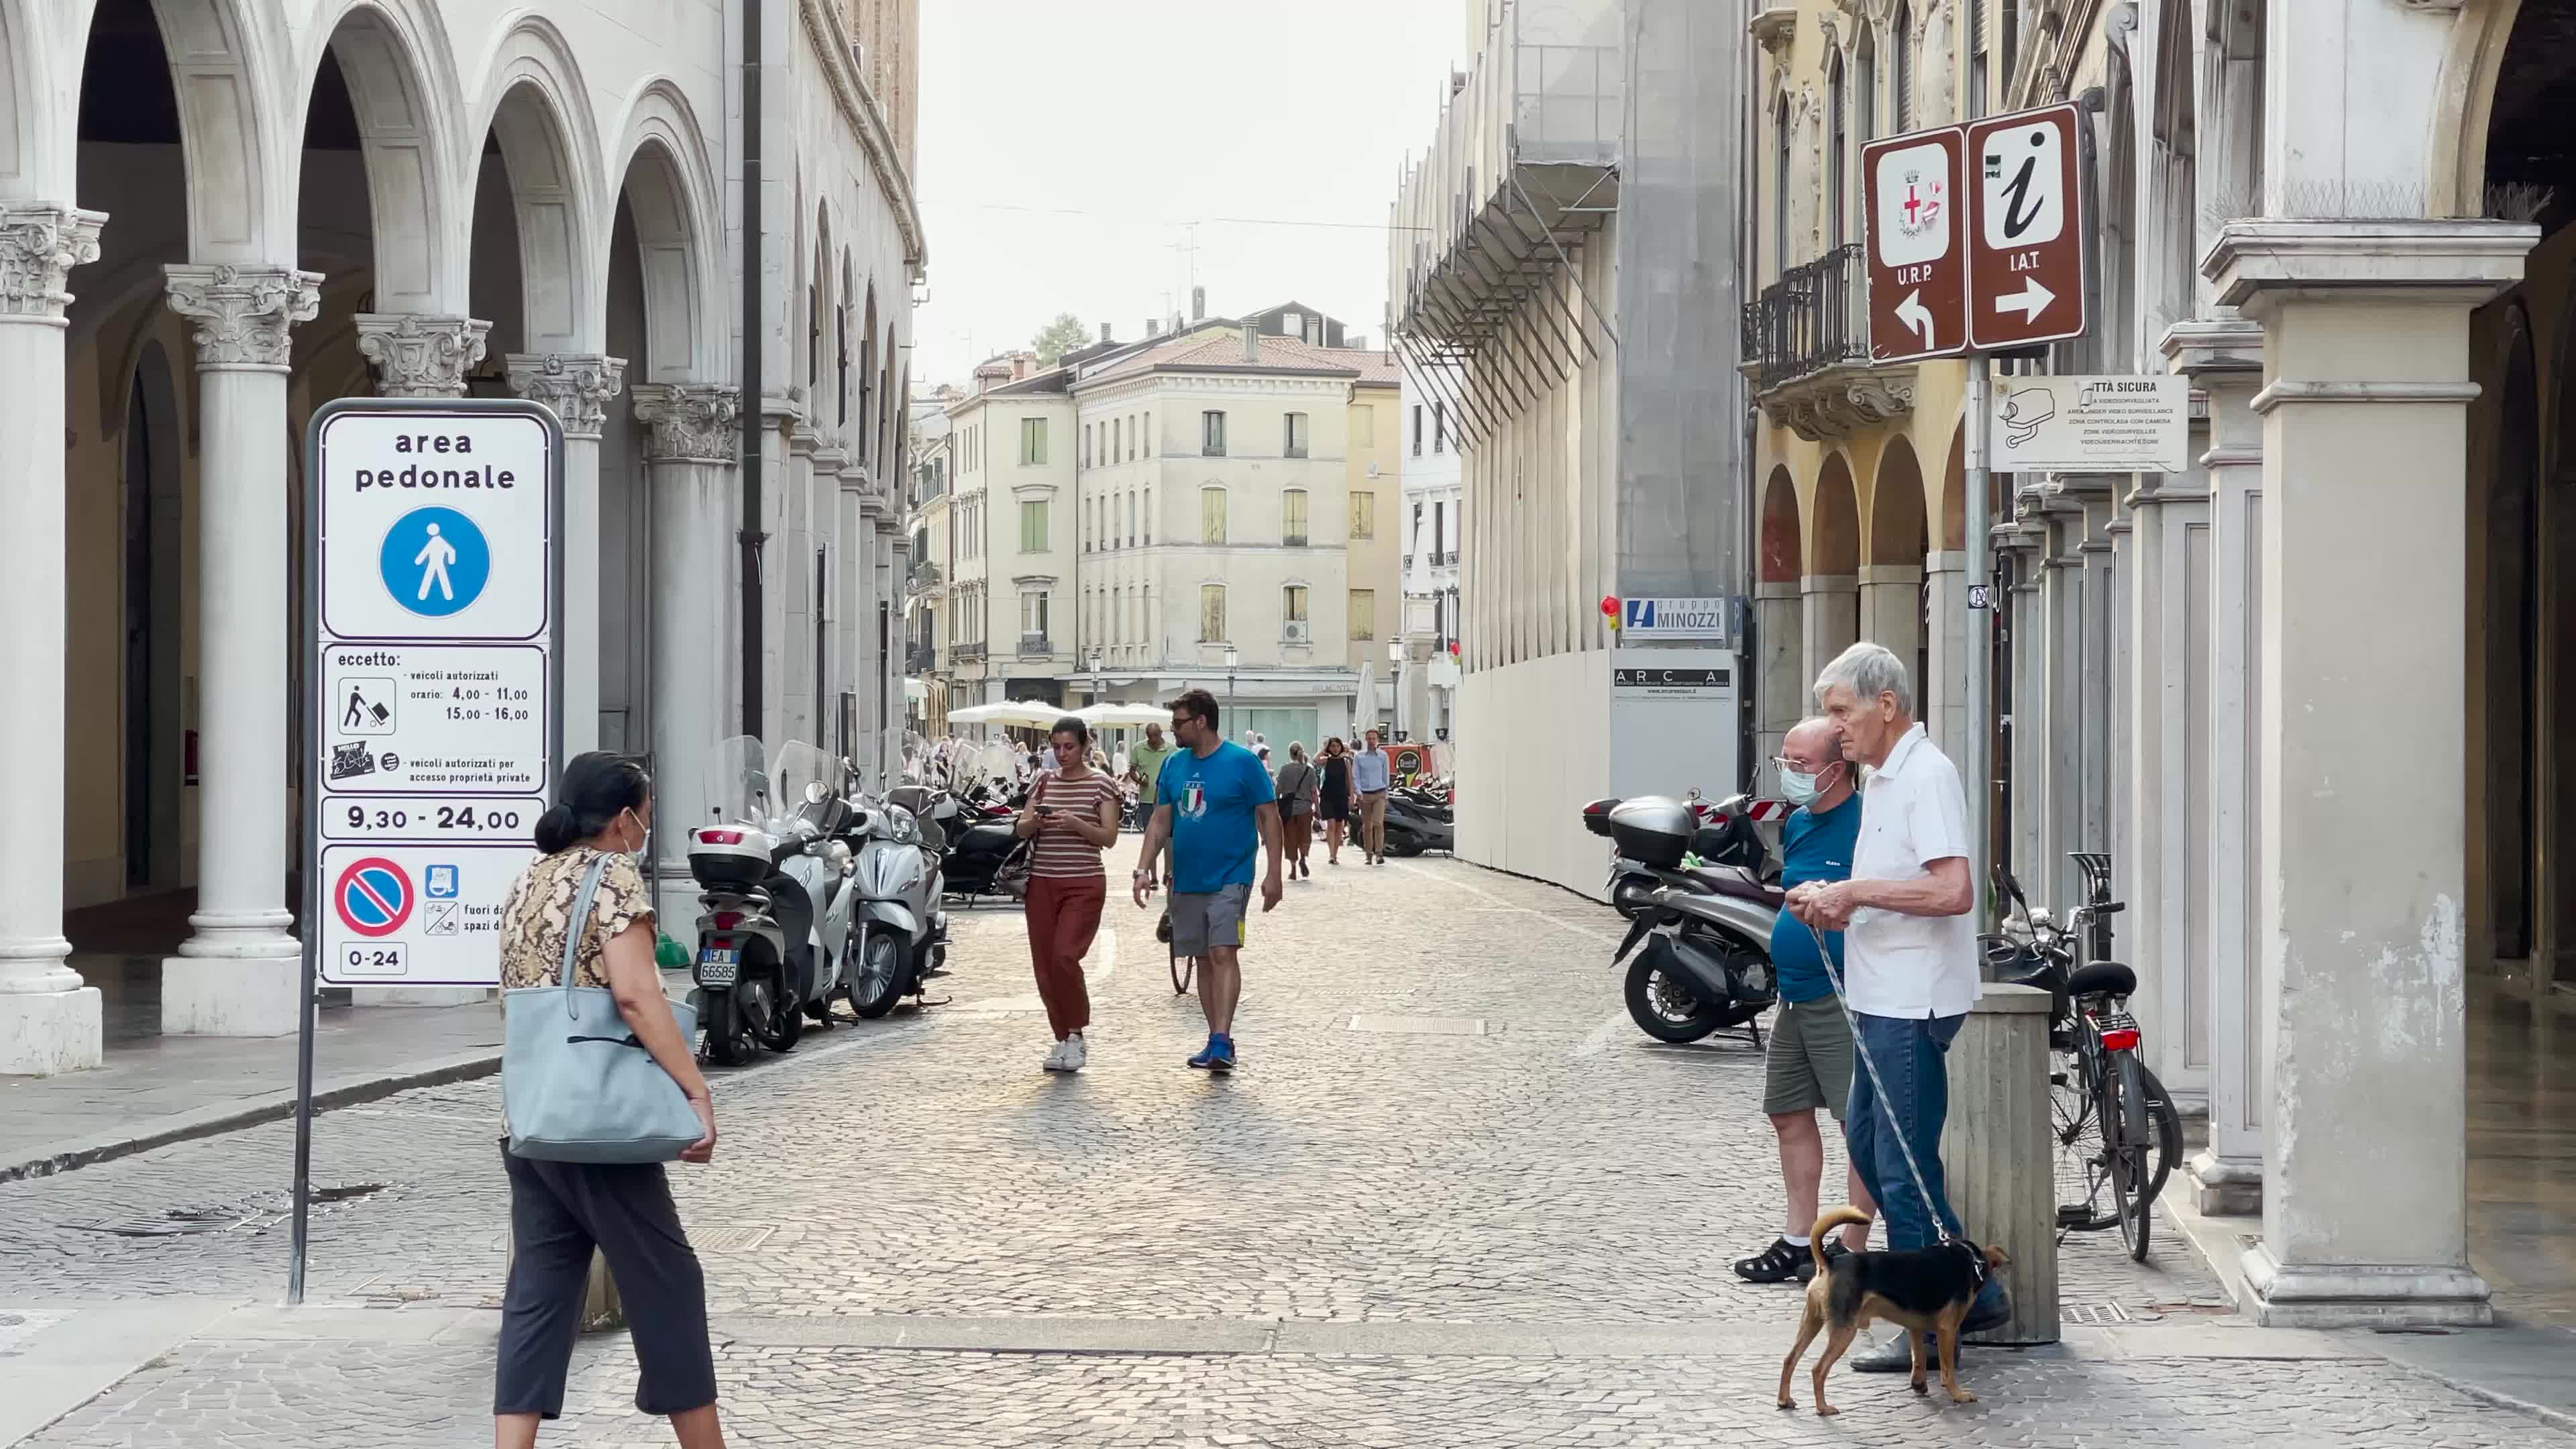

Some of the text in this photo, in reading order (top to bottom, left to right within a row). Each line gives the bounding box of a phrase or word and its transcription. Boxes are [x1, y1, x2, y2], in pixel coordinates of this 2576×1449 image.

[2010, 251, 2040, 272] I.A.T.
[2117, 382, 2157, 392] SICURA
[395, 435, 472, 453] area
[356, 464, 515, 492] pedonale
[1658, 612, 1720, 628] MINOZZI
[338, 651, 401, 666] eccetto:
[411, 671, 443, 680] veicoli
[446, 671, 498, 681] autorizzati
[411, 690, 443, 699] orario:
[452, 686, 481, 701] 4,00
[496, 686, 528, 701] 11,00
[446, 706, 481, 721] 15,00
[494, 706, 529, 721] 16,00
[410, 759, 443, 769] veicoli
[445, 759, 496, 769] autorizzati
[499, 761, 515, 771] per
[410, 772, 531, 784] accesso proprietà private
[347, 806, 407, 830] 9,30
[437, 806, 519, 831] 24,00
[464, 904, 490, 915] fuori
[464, 920, 490, 933] spazi
[349, 951, 398, 966] 0-24
[711, 949, 724, 962] EA
[702, 965, 736, 978] 66585
